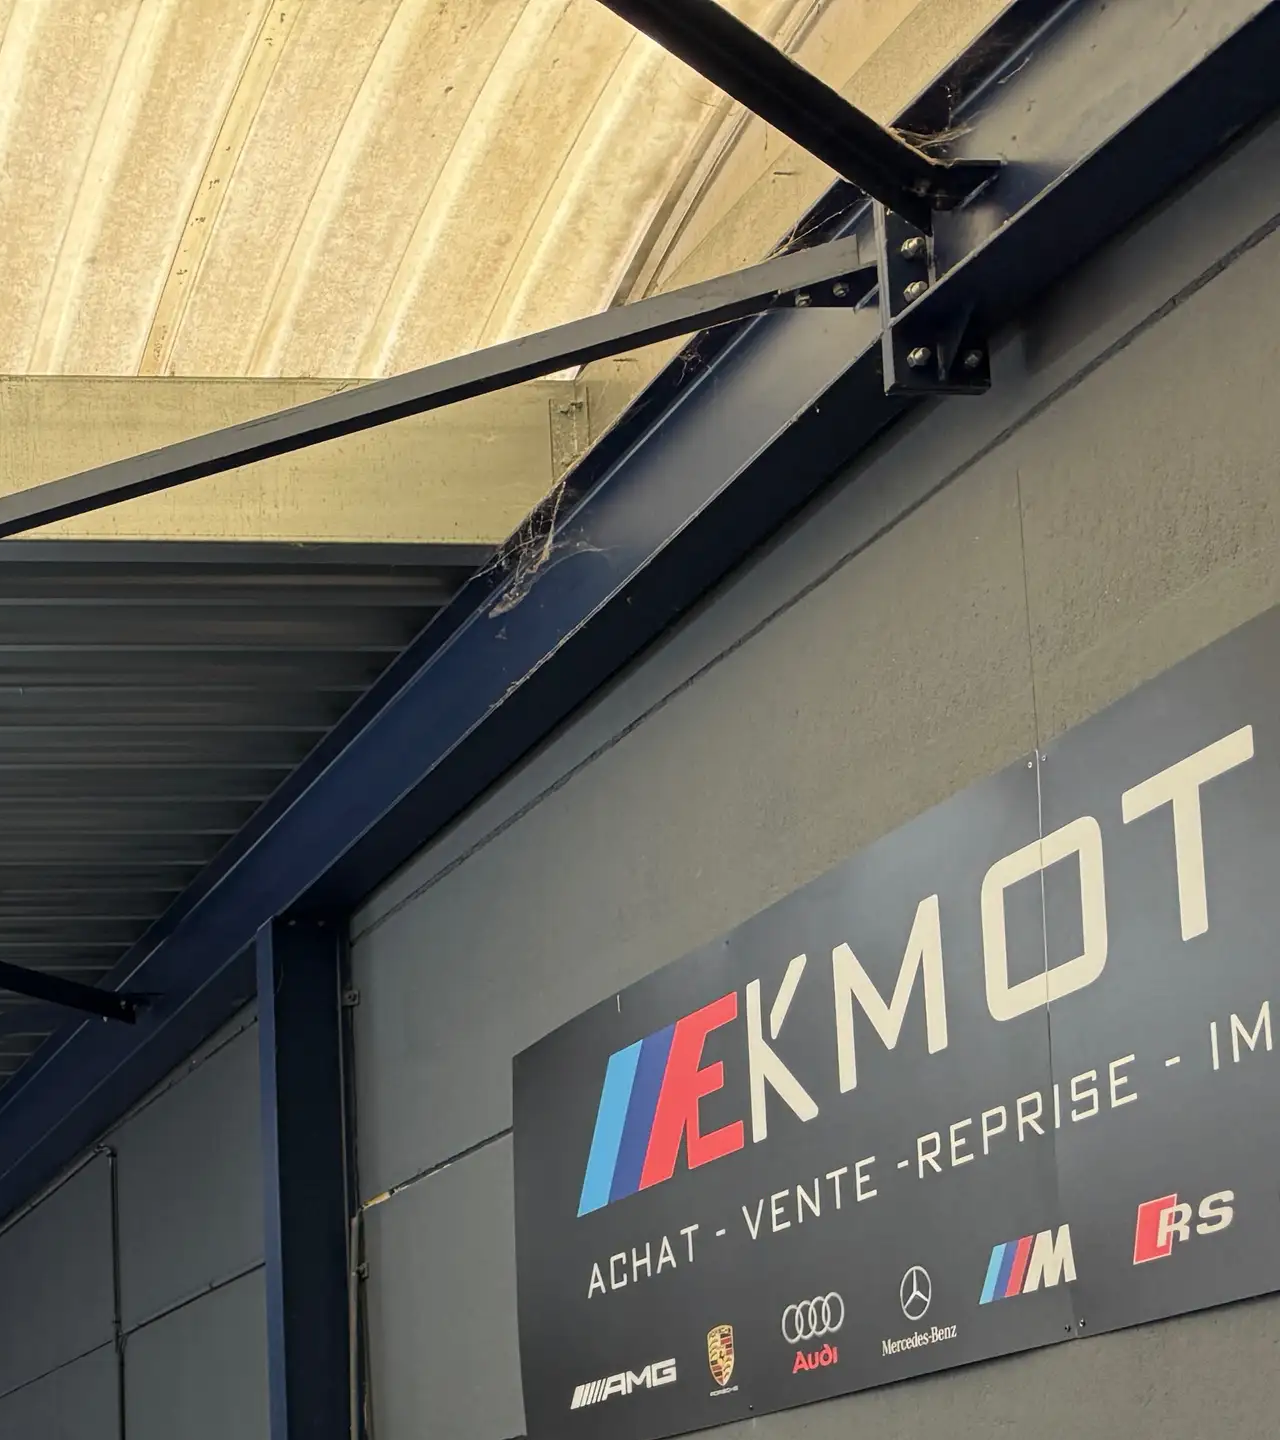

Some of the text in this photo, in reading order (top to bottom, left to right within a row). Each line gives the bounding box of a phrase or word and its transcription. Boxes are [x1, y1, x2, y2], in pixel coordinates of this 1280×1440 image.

[587, 1223, 699, 1299] ACHAT
[742, 1157, 877, 1241] VENTE
[1209, 1000, 1273, 1071] IM
[1156, 1189, 1235, 1248] RS
[792, 1343, 839, 1374] Audi
[881, 1323, 957, 1356] Mercedes-Benz
